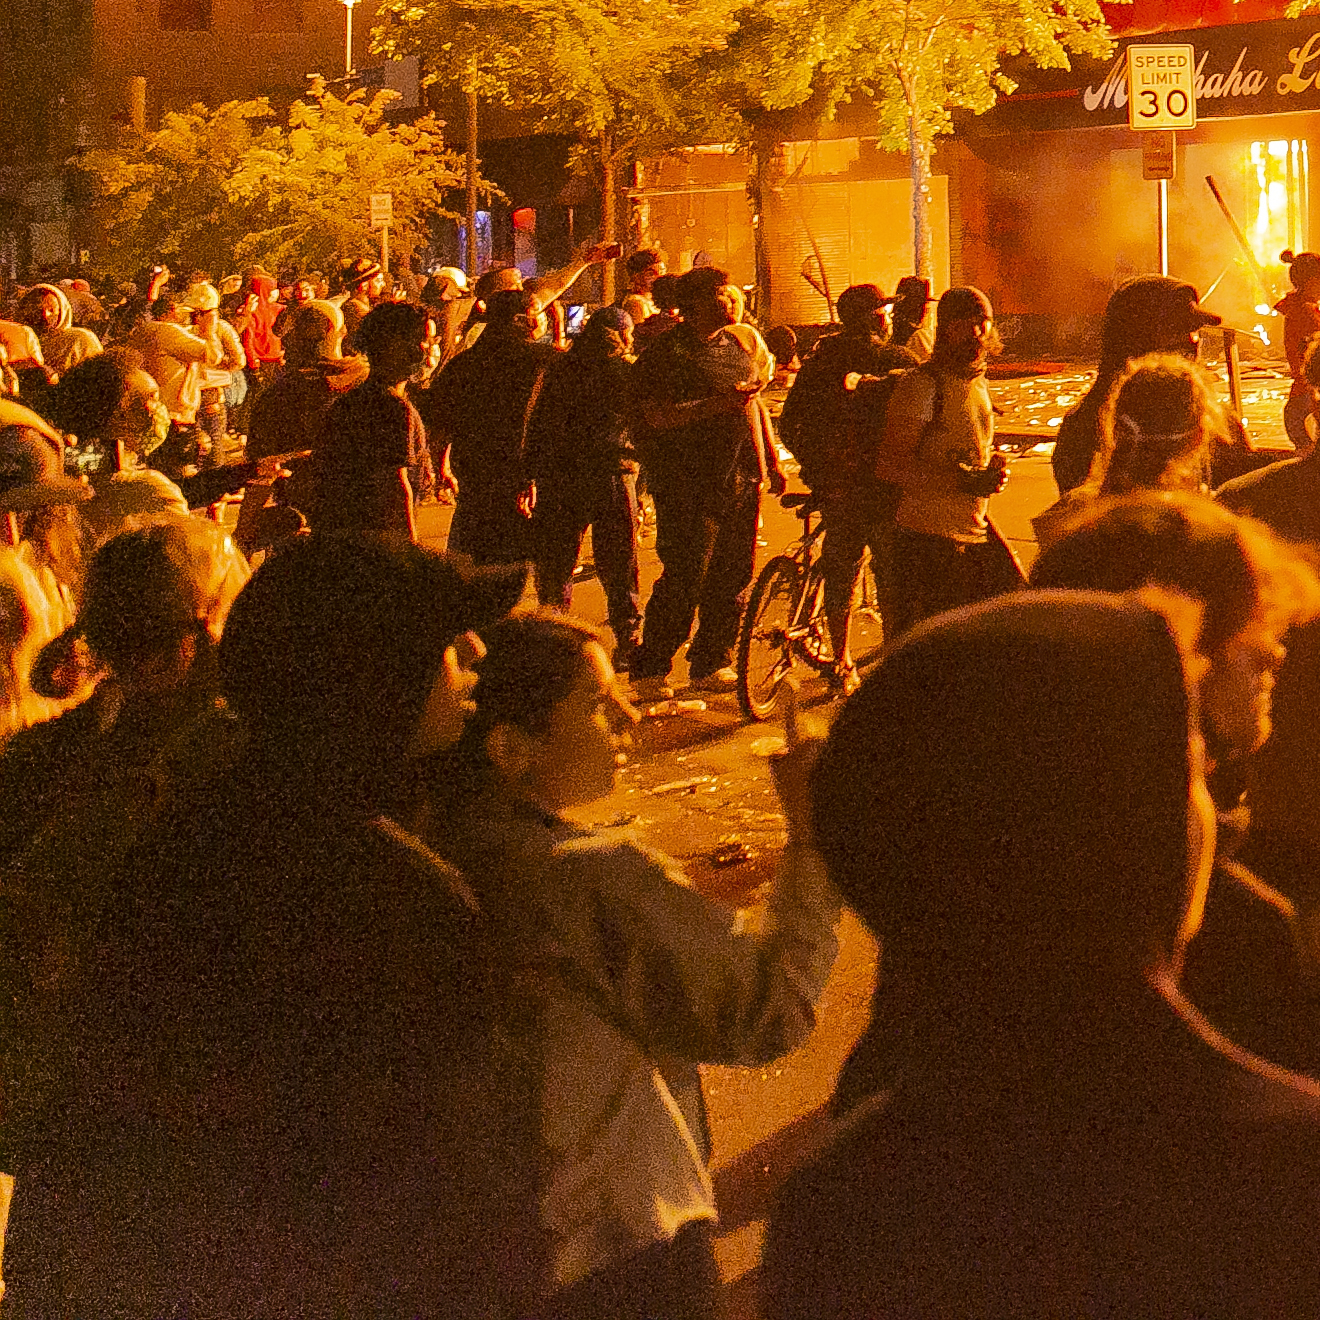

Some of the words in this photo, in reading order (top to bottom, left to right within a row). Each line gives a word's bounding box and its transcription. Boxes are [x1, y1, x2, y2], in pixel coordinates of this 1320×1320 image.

[1134, 55, 1188, 68] SPEED
[1141, 72, 1182, 85] LIMIT
[1139, 89, 1189, 118] 30
